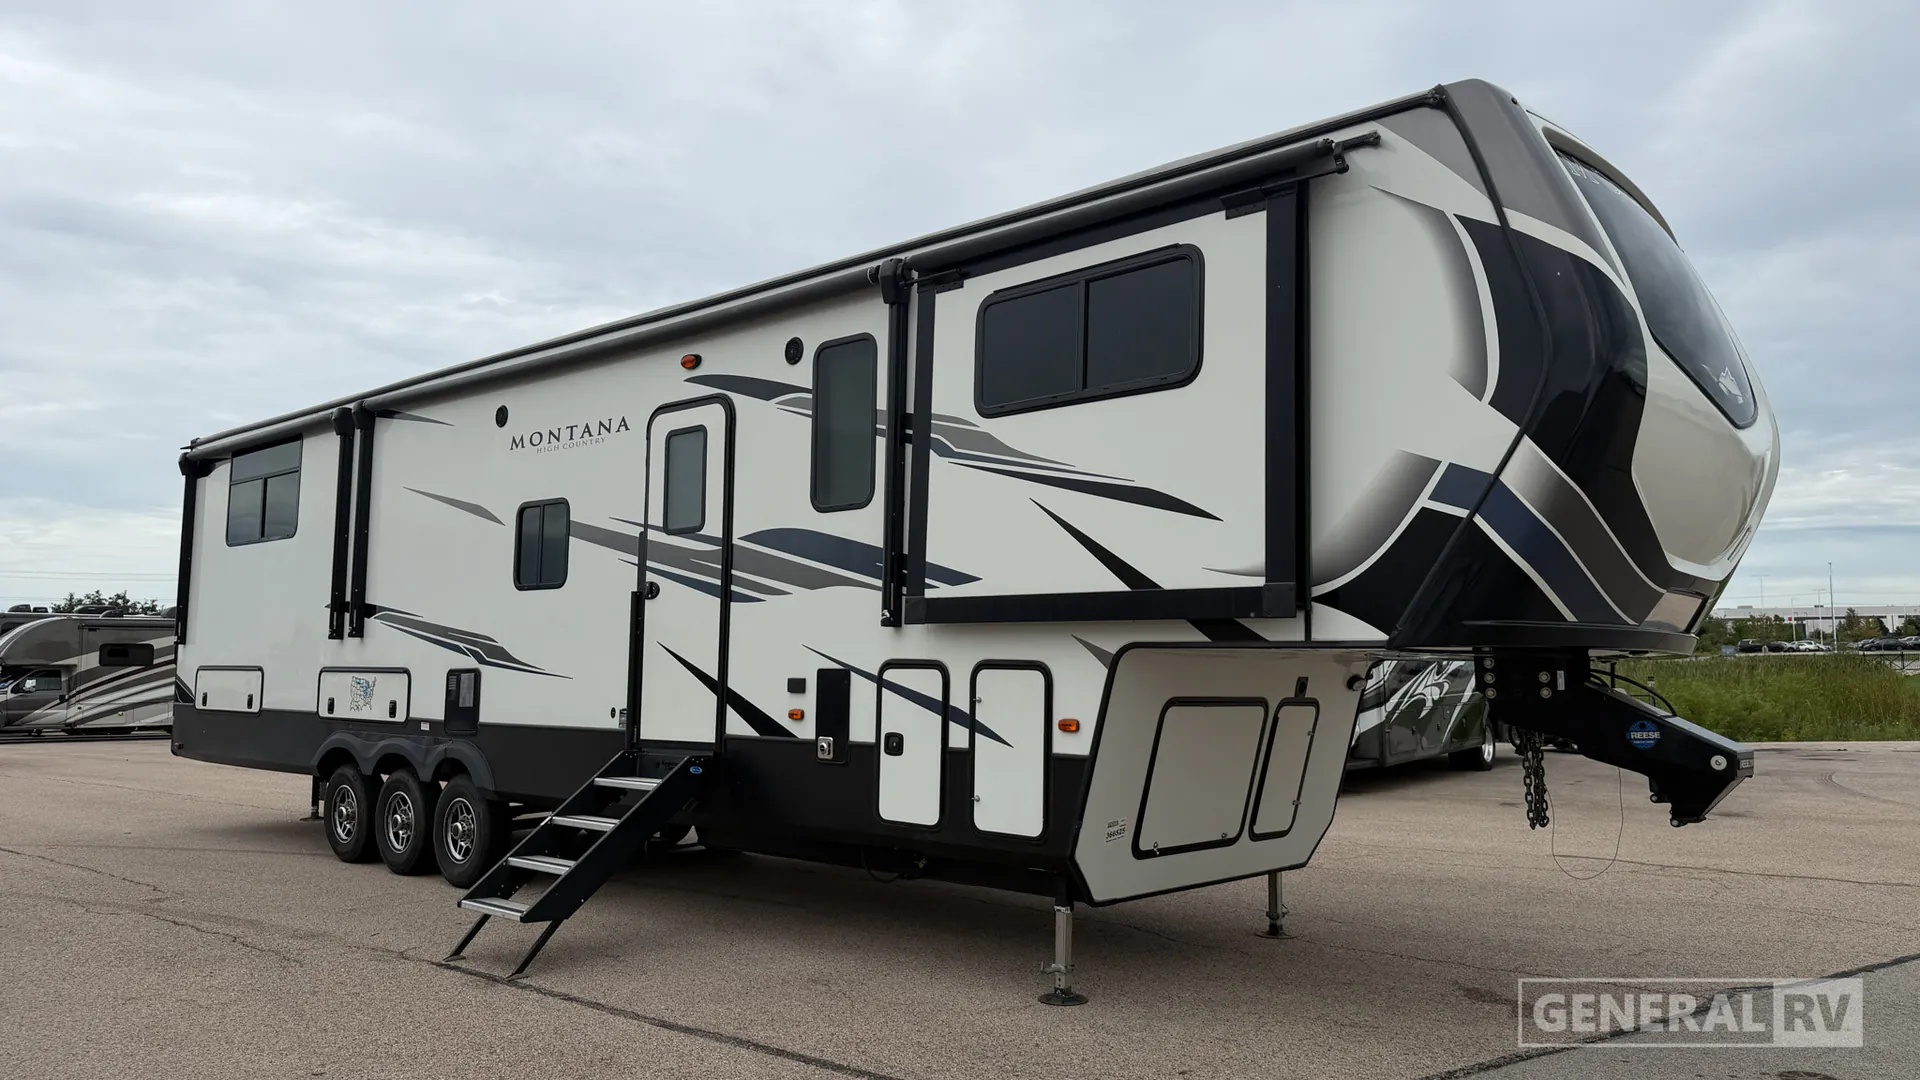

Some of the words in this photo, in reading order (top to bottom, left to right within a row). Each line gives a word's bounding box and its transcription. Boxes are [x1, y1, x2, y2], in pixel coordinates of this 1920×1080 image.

[510, 415, 630, 450] MONTANA
[536, 444, 560, 454] HIGH
[562, 436, 607, 450] COUNTRY
[1630, 731, 1660, 739] REESE
